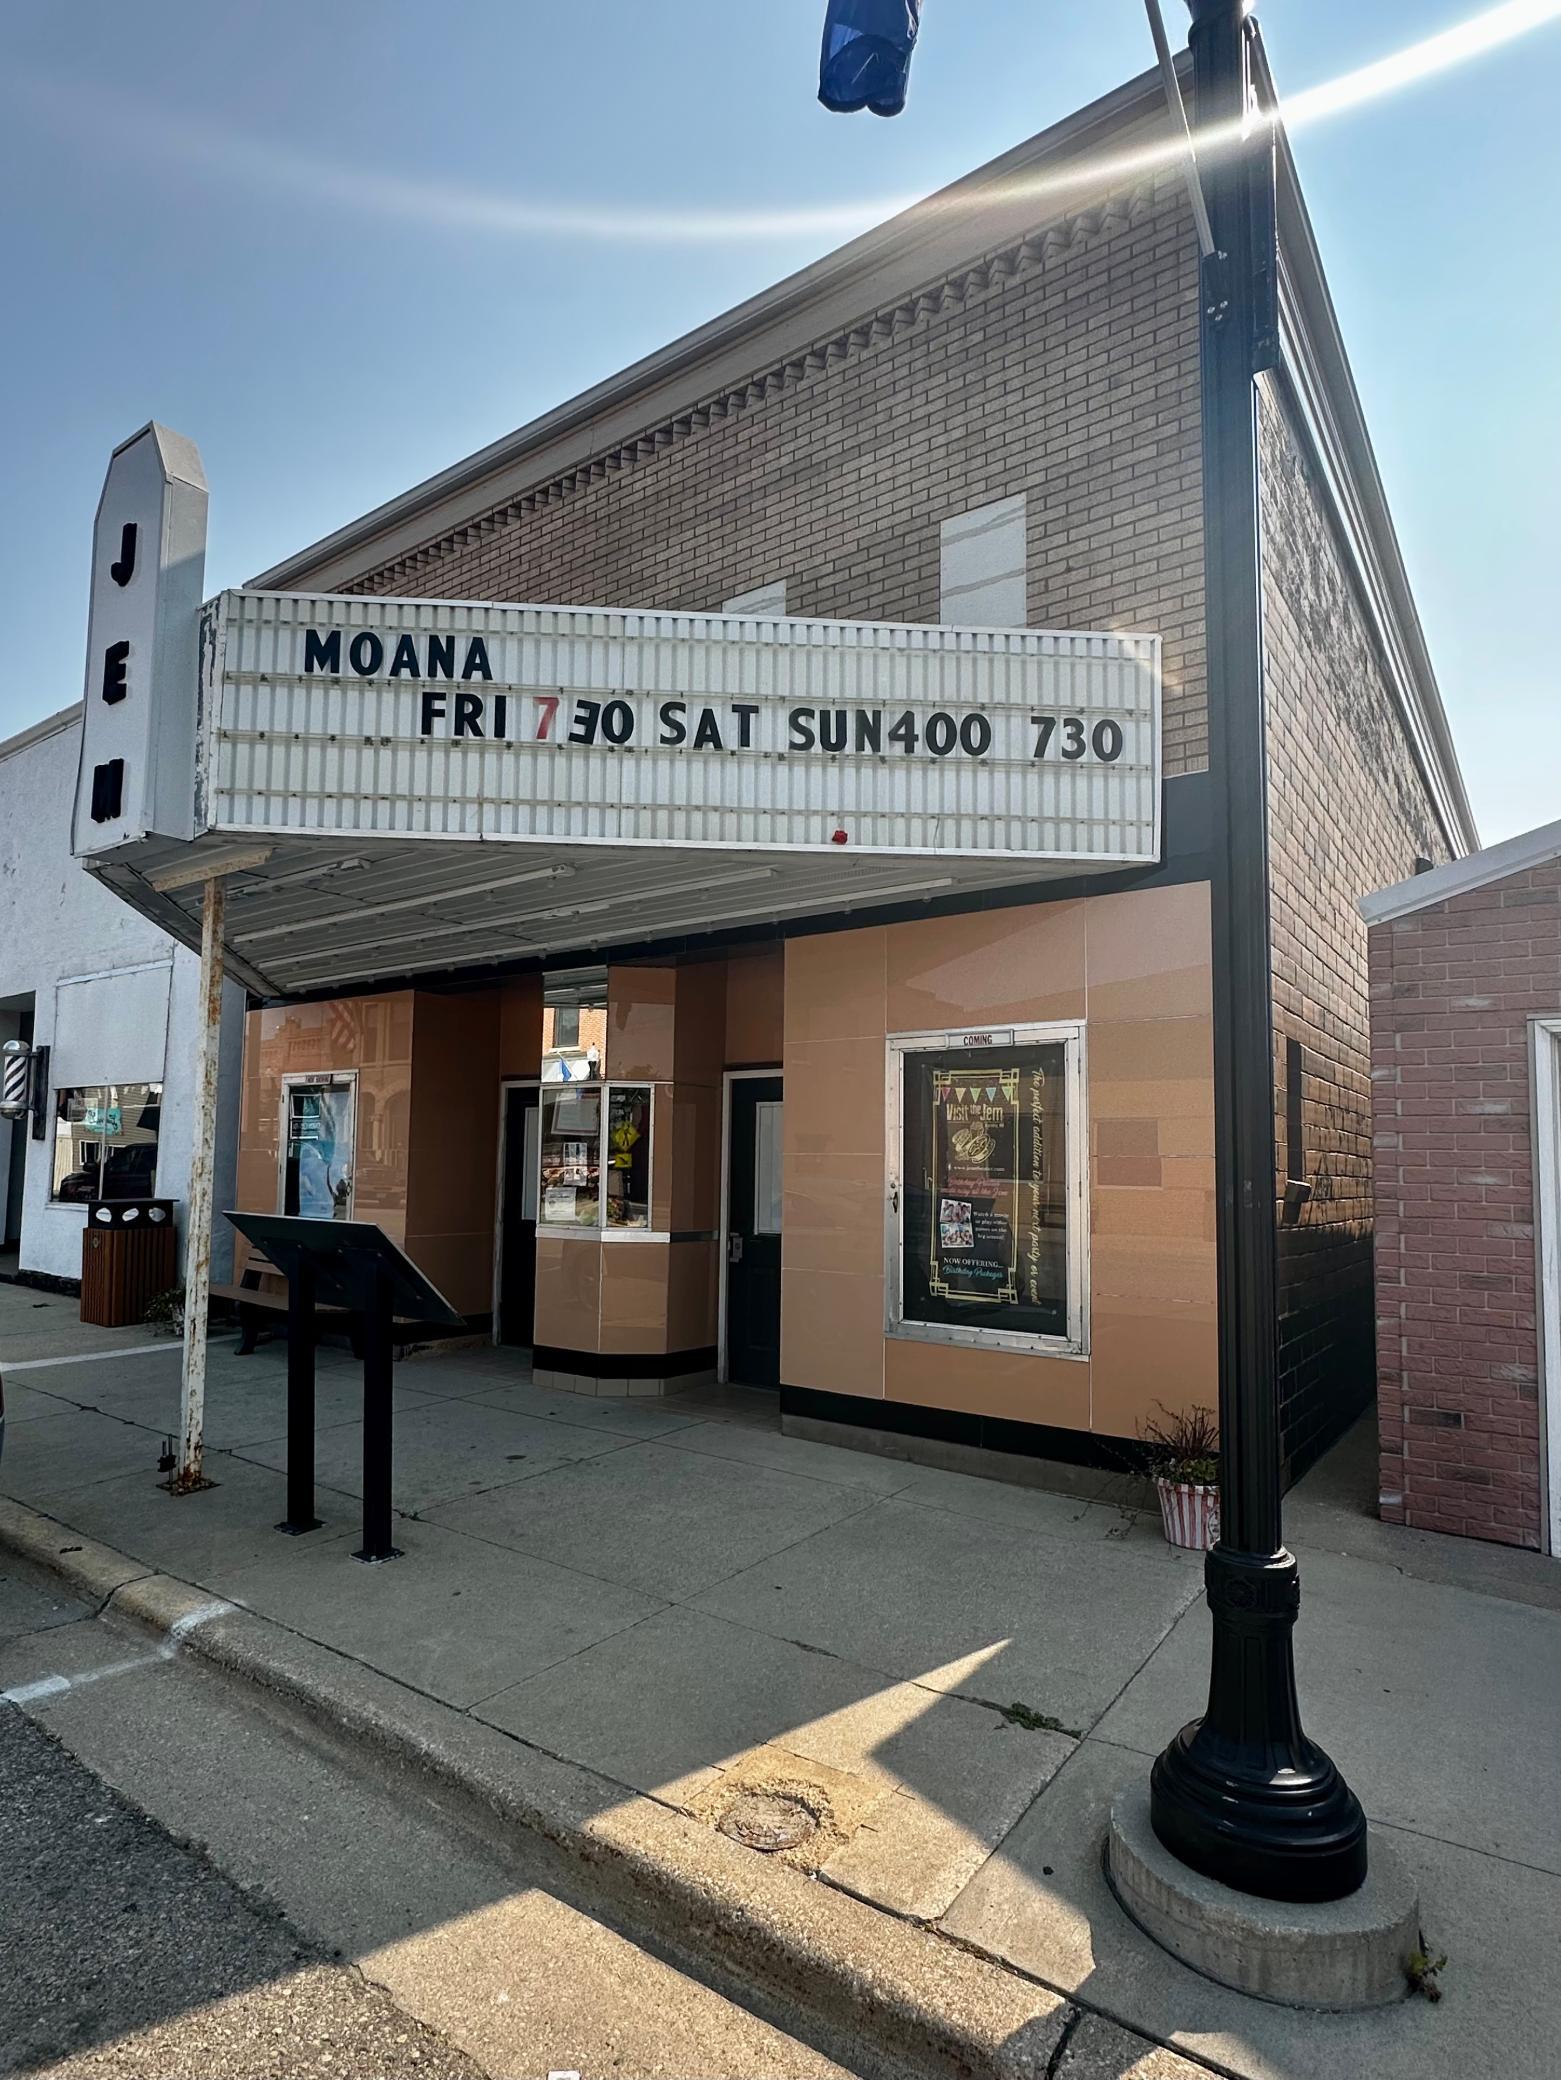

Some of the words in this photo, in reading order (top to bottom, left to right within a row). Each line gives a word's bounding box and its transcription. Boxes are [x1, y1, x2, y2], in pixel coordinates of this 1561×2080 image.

[304, 629, 493, 681] MOANA
[421, 691, 507, 738] FRI
[659, 701, 760, 751] SAT
[1030, 716, 1124, 762] 730
[963, 1034, 993, 1046] COMING
[1032, 1067, 1045, 1088] The
[946, 1103, 970, 1121] Visit
[980, 1103, 1003, 1122] Jem
[1029, 1087, 1045, 1124] perfect
[1032, 1125, 1043, 1168] addition
[1032, 1169, 1043, 1182] to
[1028, 1181, 1041, 1208] your
[1031, 1207, 1042, 1232] next
[1027, 1231, 1042, 1263] party
[1029, 1279, 1042, 1305] event
